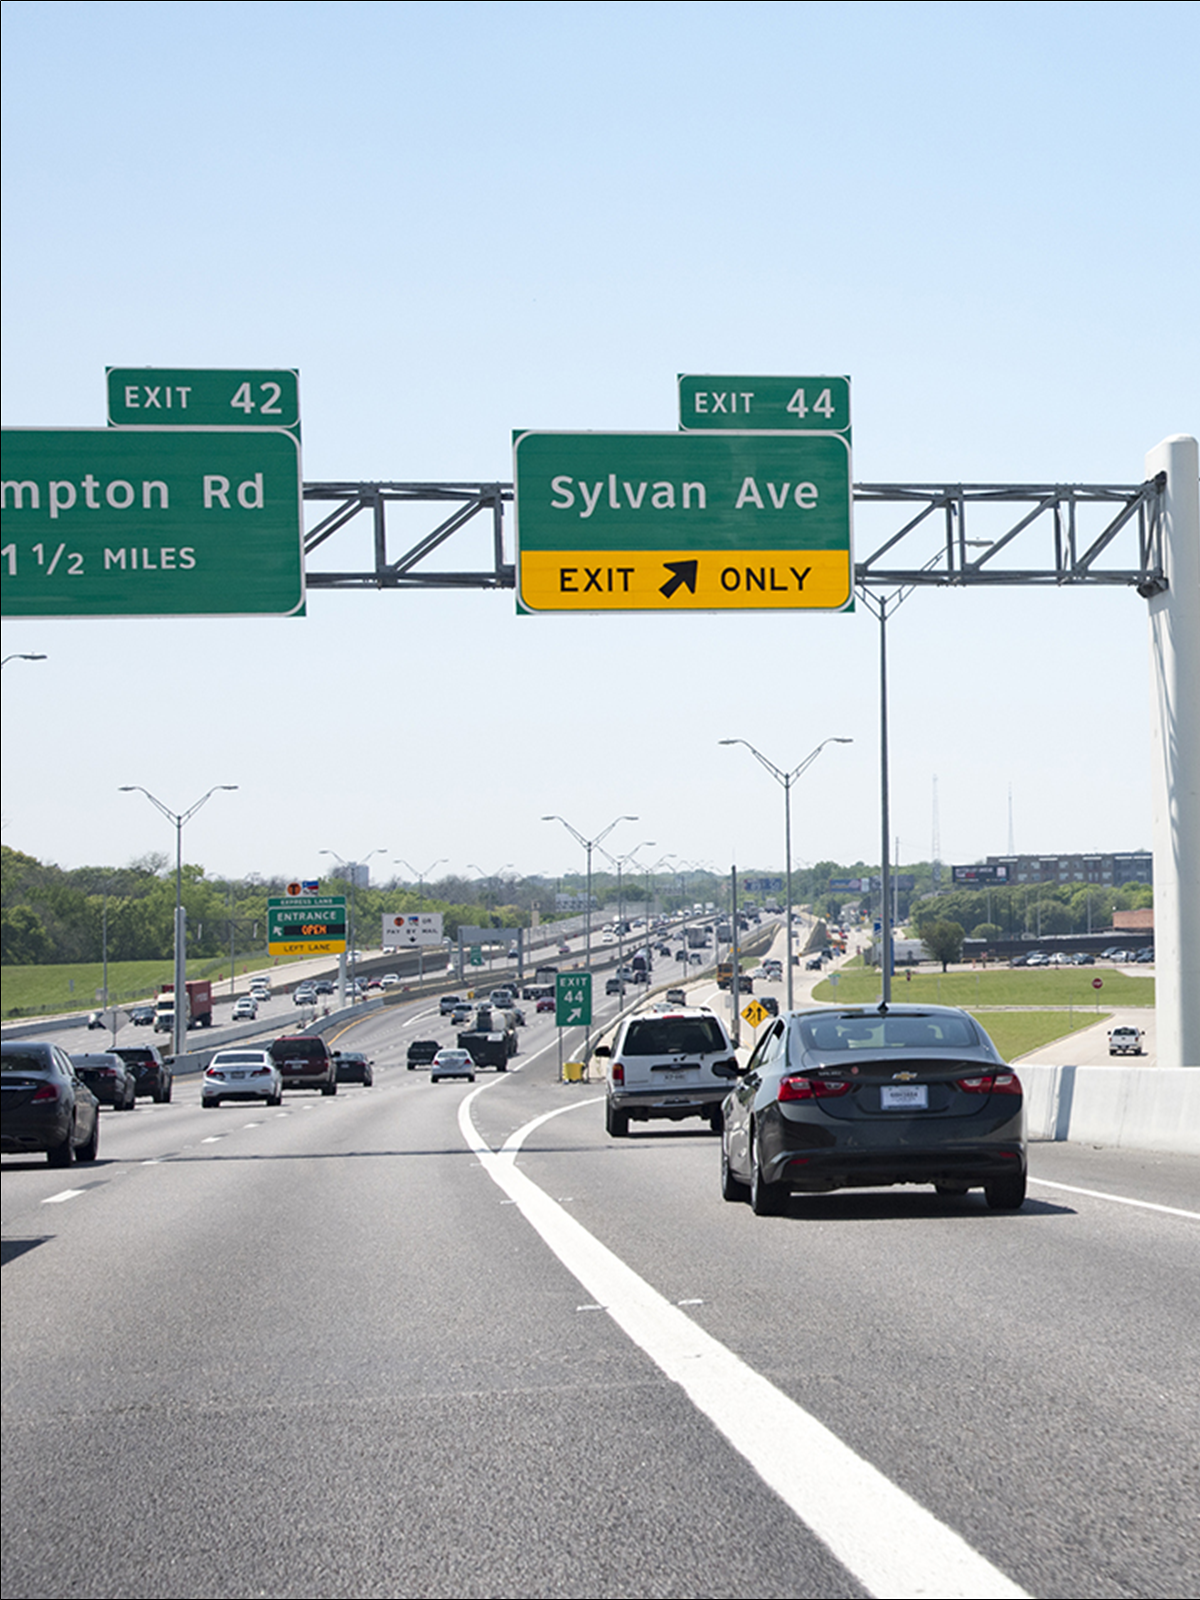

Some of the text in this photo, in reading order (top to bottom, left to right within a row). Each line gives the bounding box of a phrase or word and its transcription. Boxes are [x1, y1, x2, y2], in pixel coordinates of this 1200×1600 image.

[125, 382, 283, 414] EXIT 42
[694, 388, 836, 419] EXIT 44
[203, 472, 265, 509] Rd
[550, 474, 819, 517] Sylvan Ave
[104, 547, 196, 570] MILES
[559, 567, 812, 592] EXIT ONLY
[277, 911, 337, 922] ENTRANCE
[301, 924, 327, 935] OPEN
[284, 943, 331, 952] LEFT LANE
[560, 976, 588, 987] EXIT
[563, 990, 584, 1004] 44
